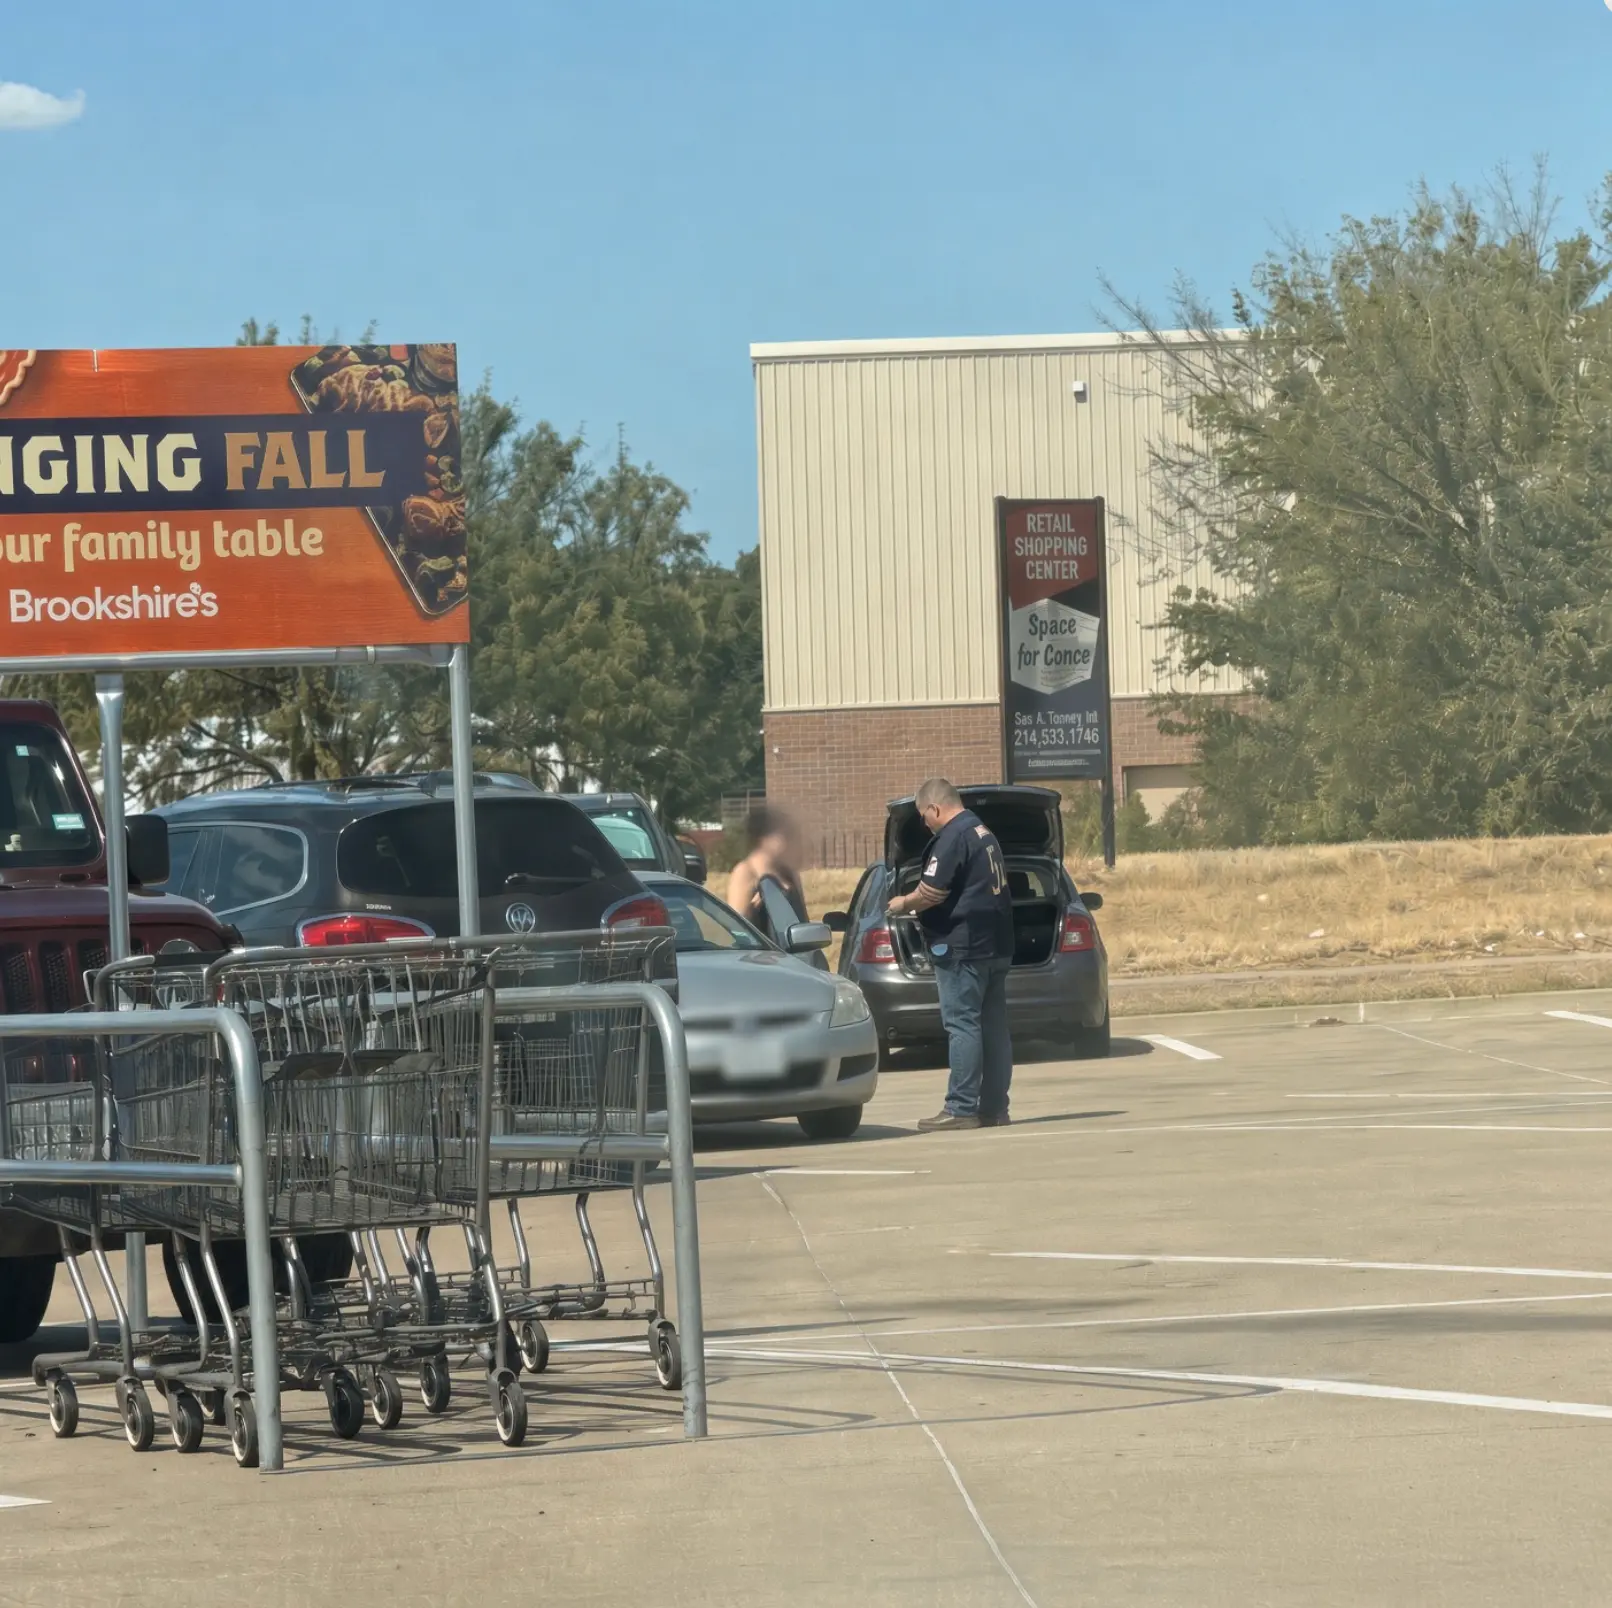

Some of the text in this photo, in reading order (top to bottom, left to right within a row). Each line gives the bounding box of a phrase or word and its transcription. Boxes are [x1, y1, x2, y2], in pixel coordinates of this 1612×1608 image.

[0, 430, 386, 495] GING FALL
[1026, 513, 1075, 533] RETAIL
[0, 518, 324, 572] ur family table
[1014, 536, 1088, 557] SHOPPING
[1025, 560, 1079, 580] CENTER
[9, 582, 219, 622] Brookshire's
[1028, 613, 1077, 641] Space
[1017, 642, 1091, 670] for Conce
